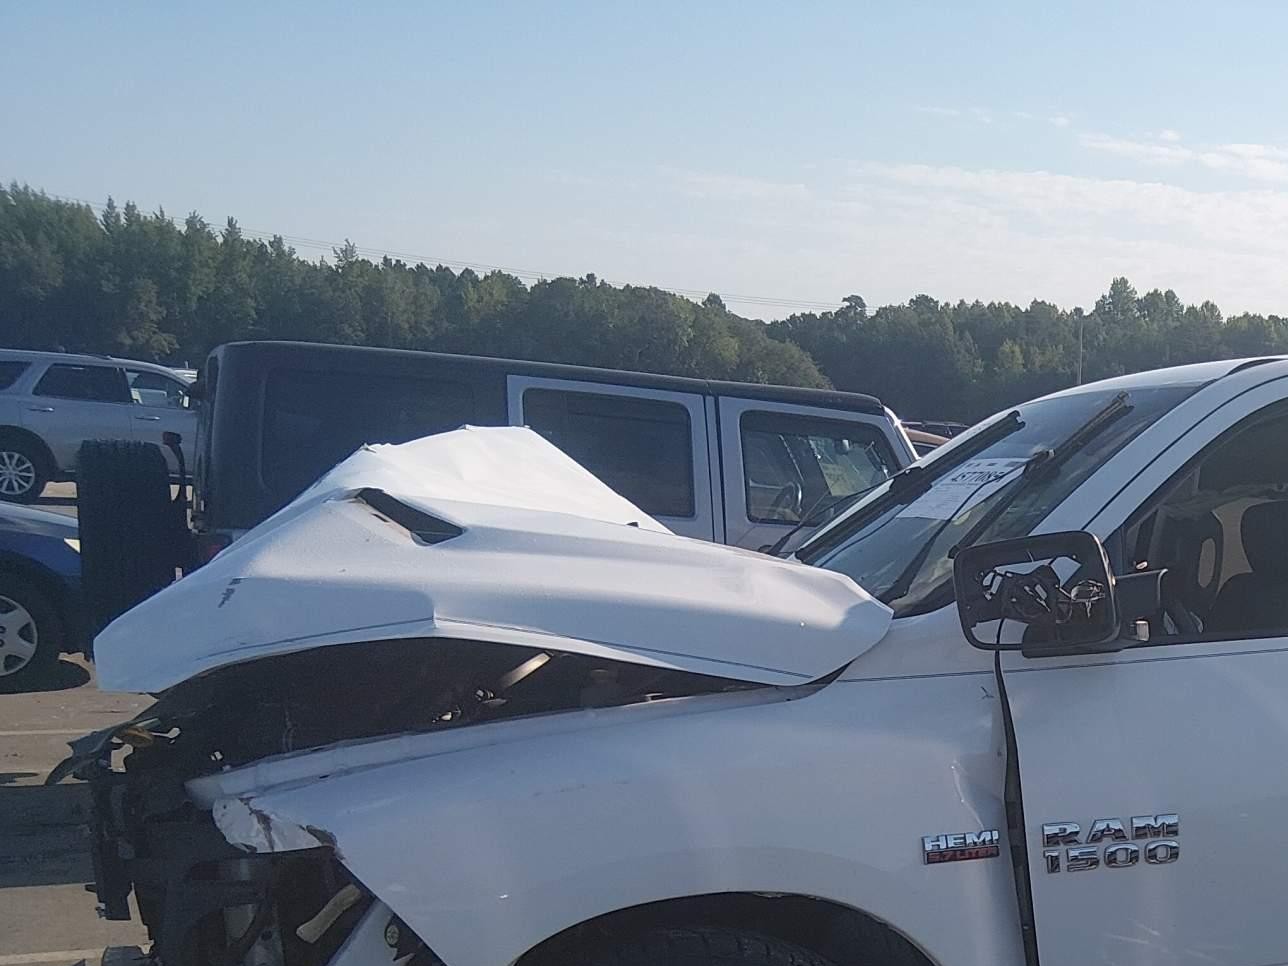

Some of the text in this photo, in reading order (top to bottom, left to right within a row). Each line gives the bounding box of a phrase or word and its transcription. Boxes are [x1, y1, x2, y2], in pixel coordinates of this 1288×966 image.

[921, 830, 999, 851] HEMI
[1042, 813, 1180, 847] RAM
[1043, 840, 1180, 873] 1500
